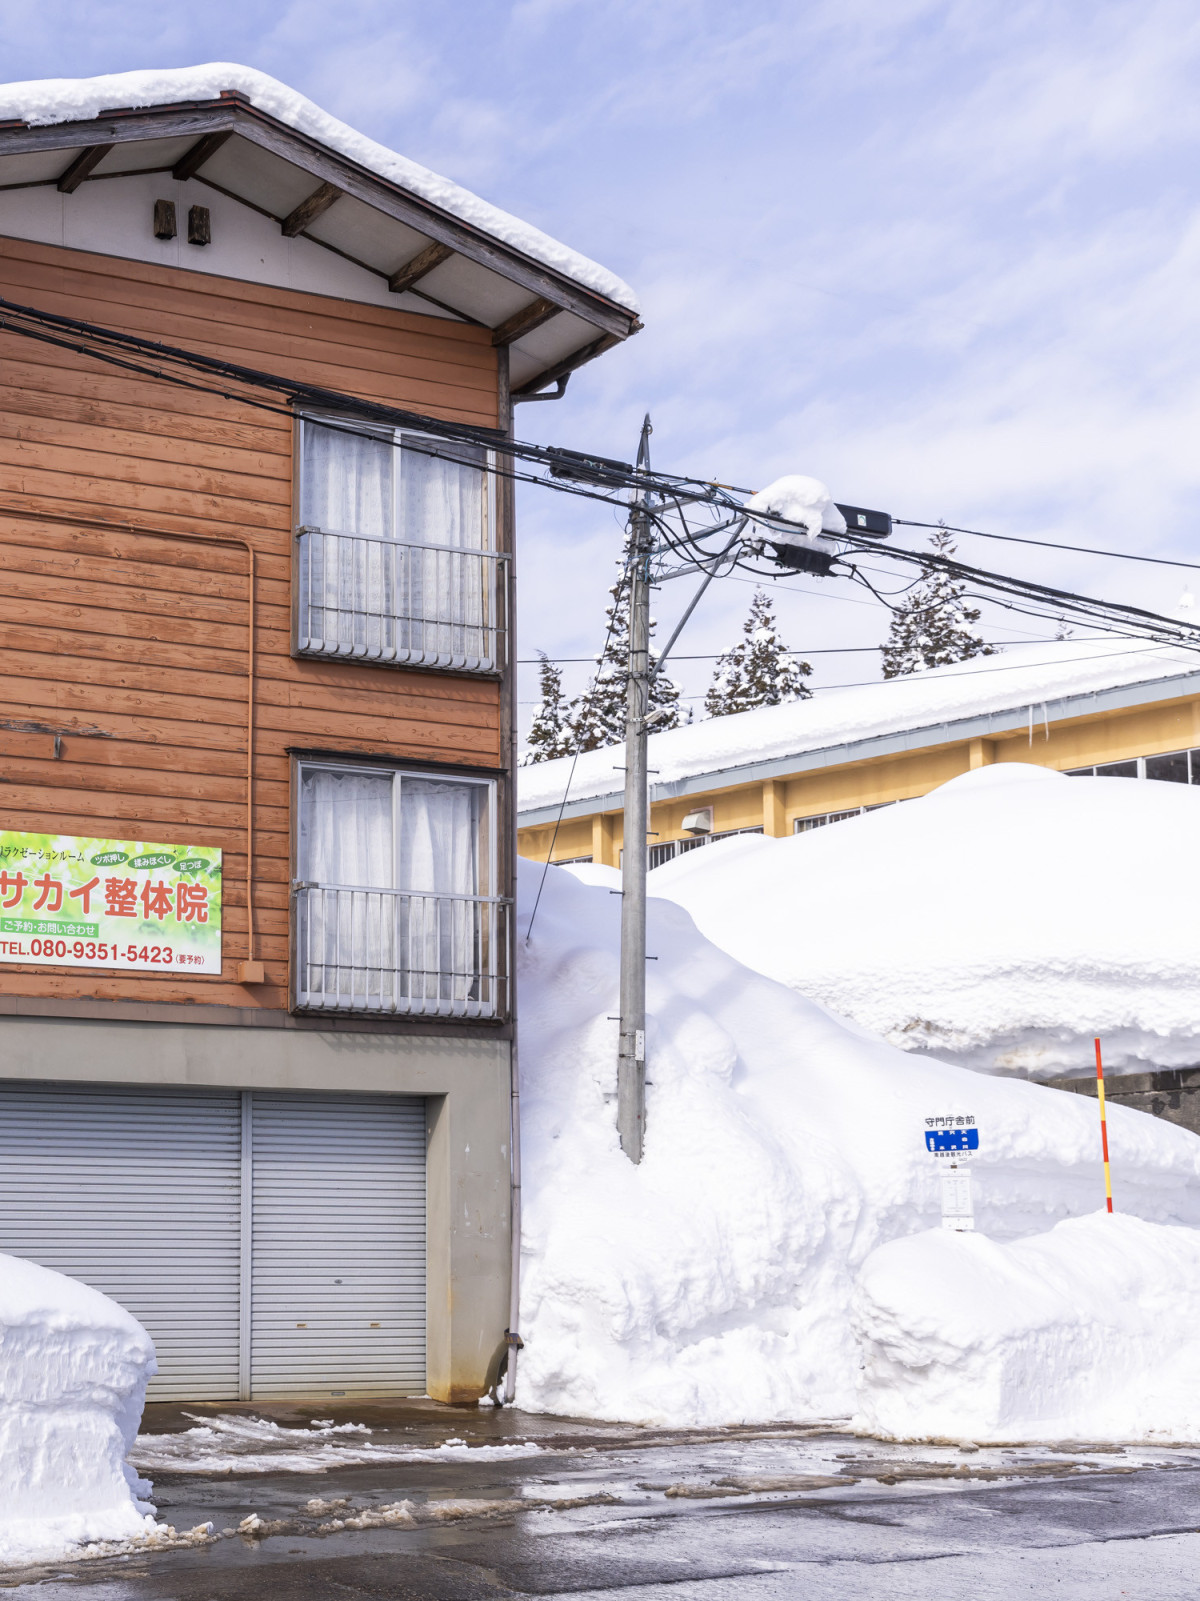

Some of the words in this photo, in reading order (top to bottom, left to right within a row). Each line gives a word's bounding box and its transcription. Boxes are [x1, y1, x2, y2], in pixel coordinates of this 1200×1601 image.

[95, 853, 126, 865] ツボ押し
[180, 860, 202, 871] 足つぼ
[4, 920, 95, 936] ご予約・お問い合わせ
[925, 1115, 976, 1127] 守門庁舎前
